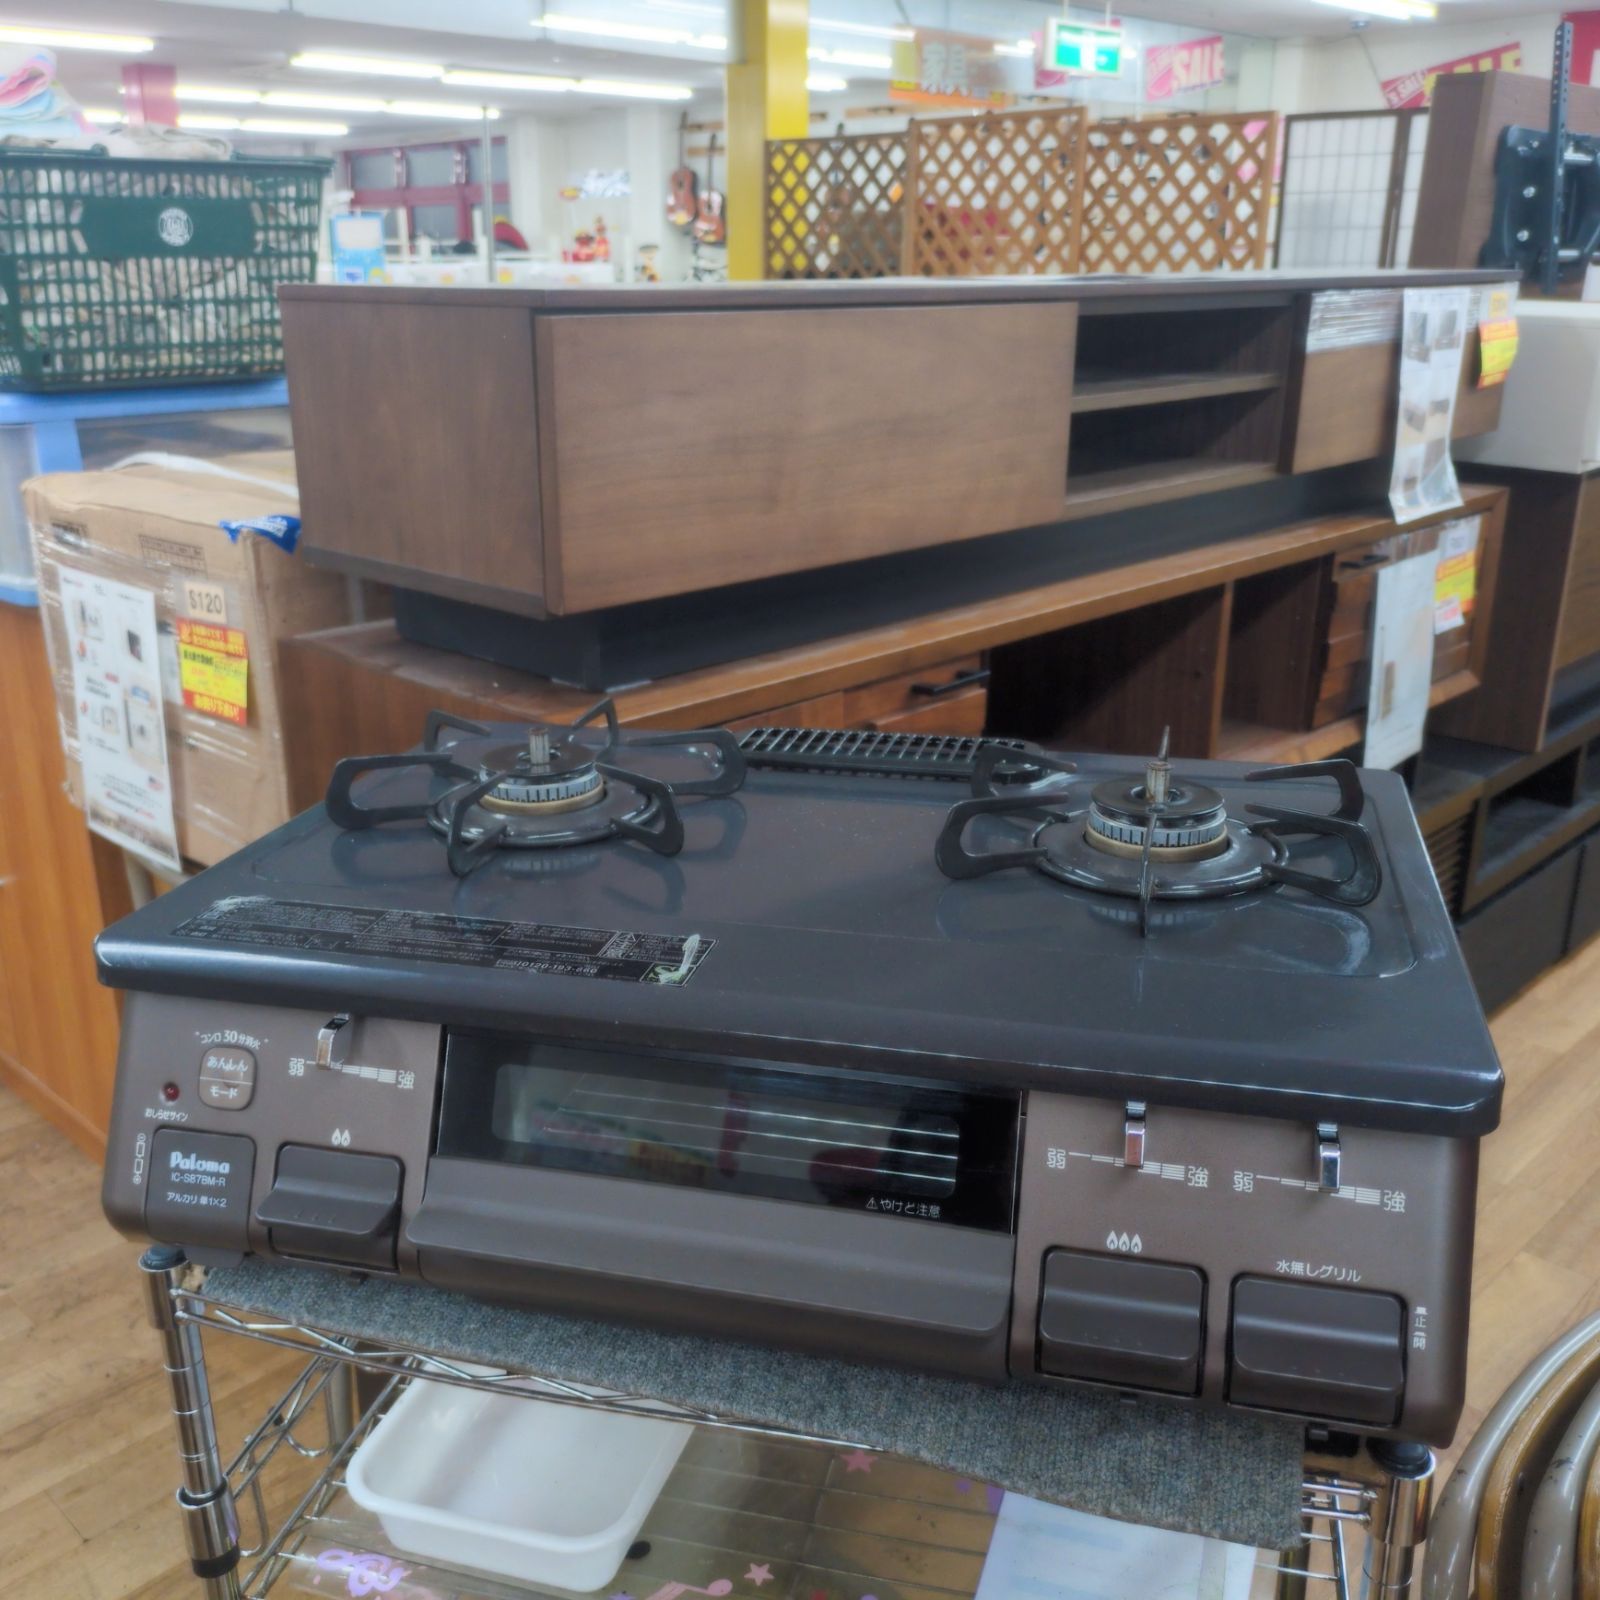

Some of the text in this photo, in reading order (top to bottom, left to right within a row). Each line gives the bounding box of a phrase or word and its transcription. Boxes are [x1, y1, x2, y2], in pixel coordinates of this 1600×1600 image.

[206, 1055, 249, 1073] あんしん
[288, 1057, 416, 1090] 弱 強
[209, 1085, 239, 1100] モード
[144, 1107, 189, 1122] おしらせサイン
[169, 1151, 231, 1174] Paloma
[1046, 1147, 1209, 1188] 弱 強
[166, 1191, 198, 1205] アルカリ
[1233, 1170, 1406, 1213] 弱 強
[879, 1199, 941, 1218] やけど注意
[1276, 1259, 1361, 1283] 水無しグリル
